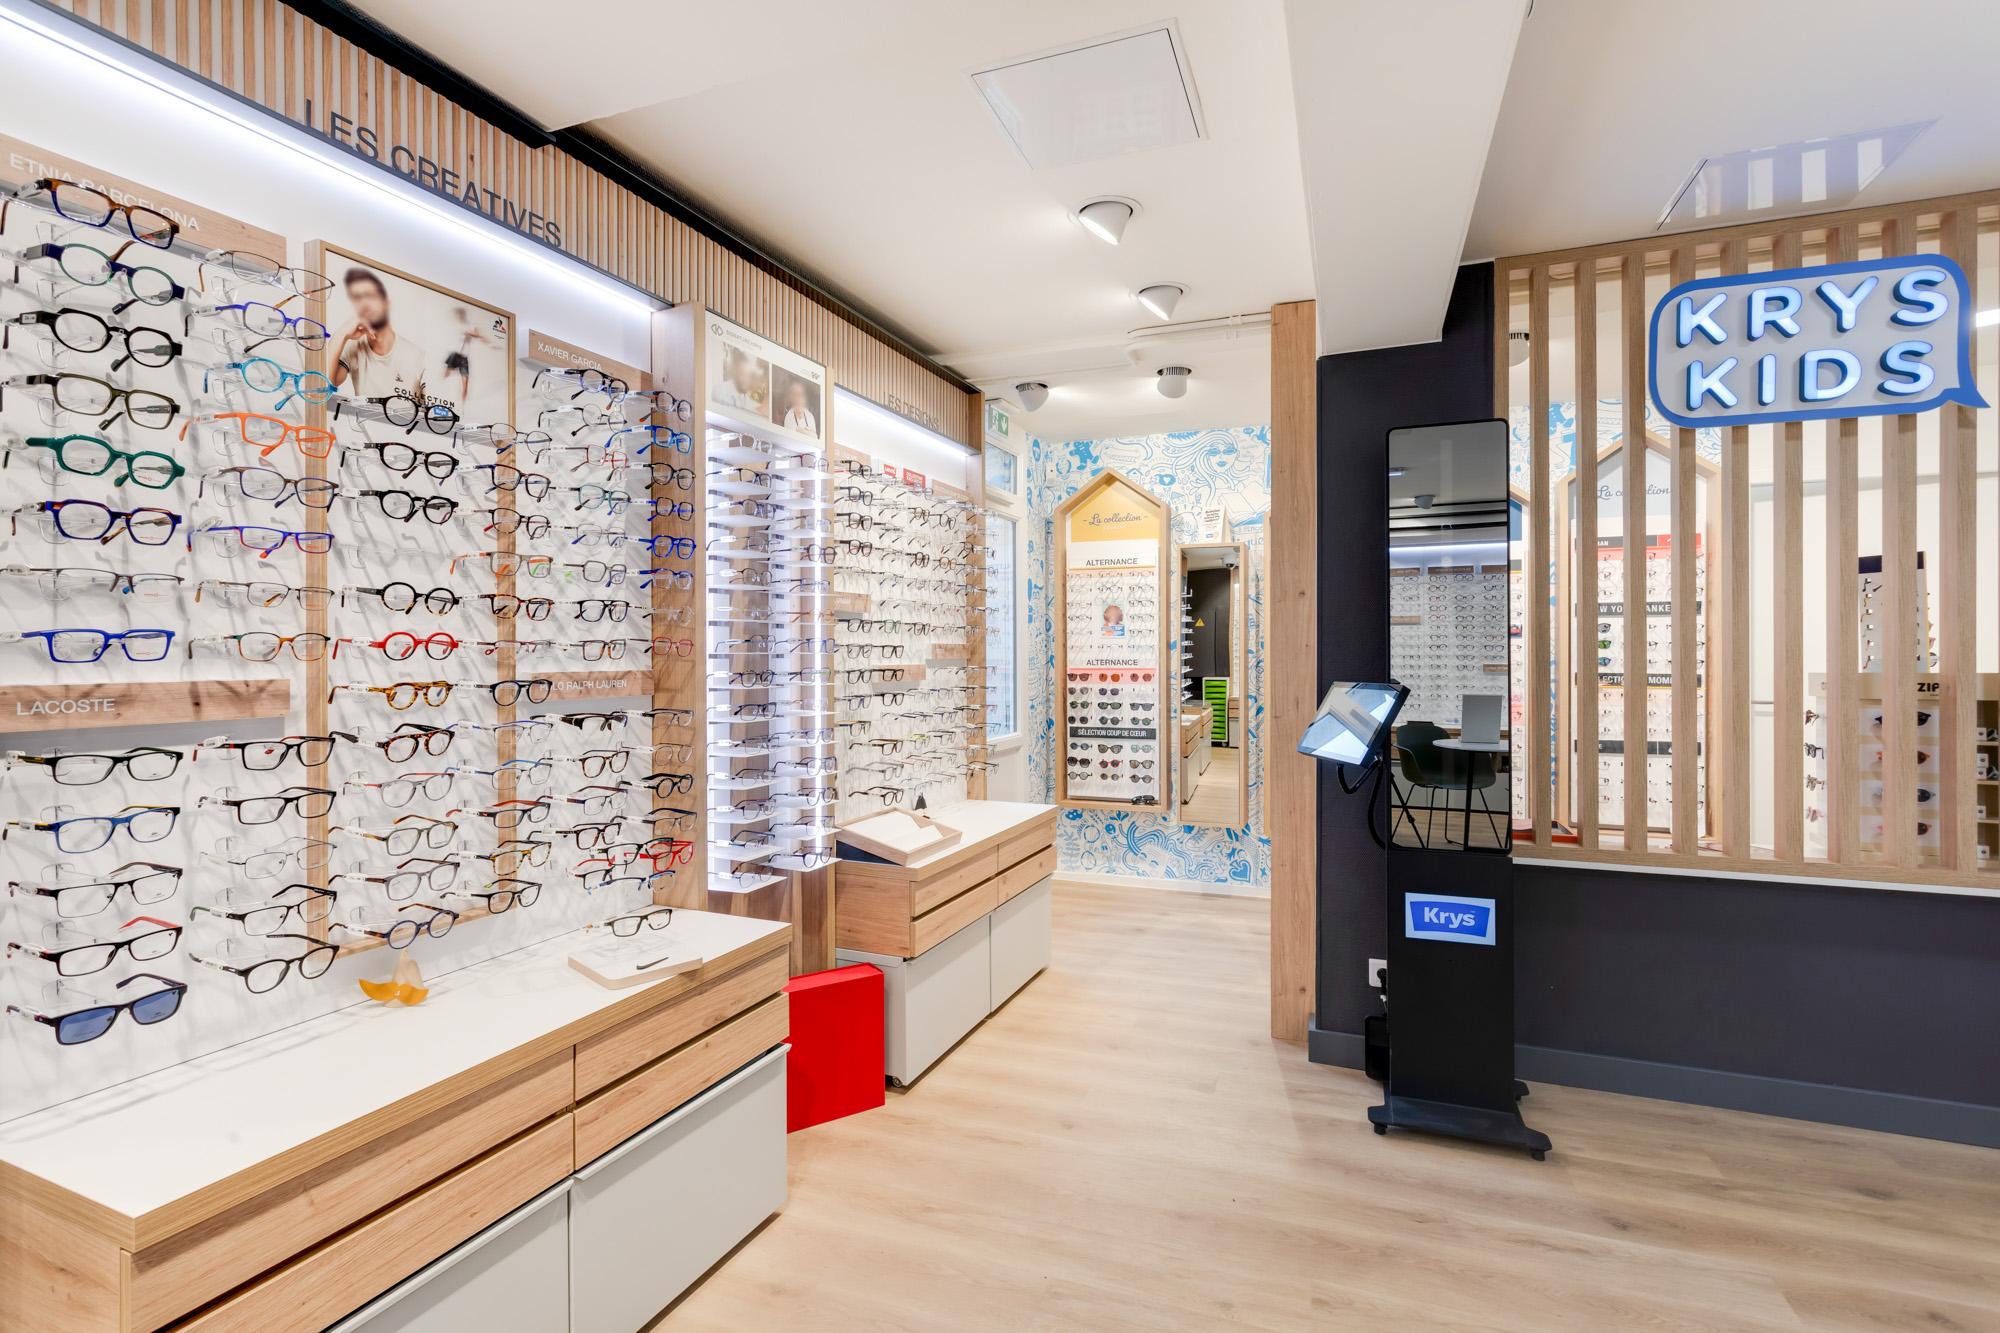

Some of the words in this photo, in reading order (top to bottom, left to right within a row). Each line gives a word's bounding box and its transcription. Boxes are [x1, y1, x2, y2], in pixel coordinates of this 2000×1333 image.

[305, 98, 380, 161] LES
[390, 145, 562, 249] CREATIVES
[1676, 269, 1949, 349] KRYS
[537, 342, 569, 361] XAVIER
[570, 354, 602, 371] GARCIA
[1686, 340, 1936, 411] KIDS
[394, 387, 455, 408] COLLECTION
[1089, 513, 1102, 526] La
[1103, 512, 1143, 524] collection
[1086, 558, 1138, 567] ALTERNANCE
[1086, 659, 1138, 667] ALTERNANCE
[566, 680, 594, 691] RALPH
[596, 680, 627, 690] LAUREN
[16, 698, 115, 716] LACOSTE
[1077, 727, 1107, 737] SÉLECTION
[1107, 729, 1121, 737] COUP
[1423, 906, 1476, 929] Krys
